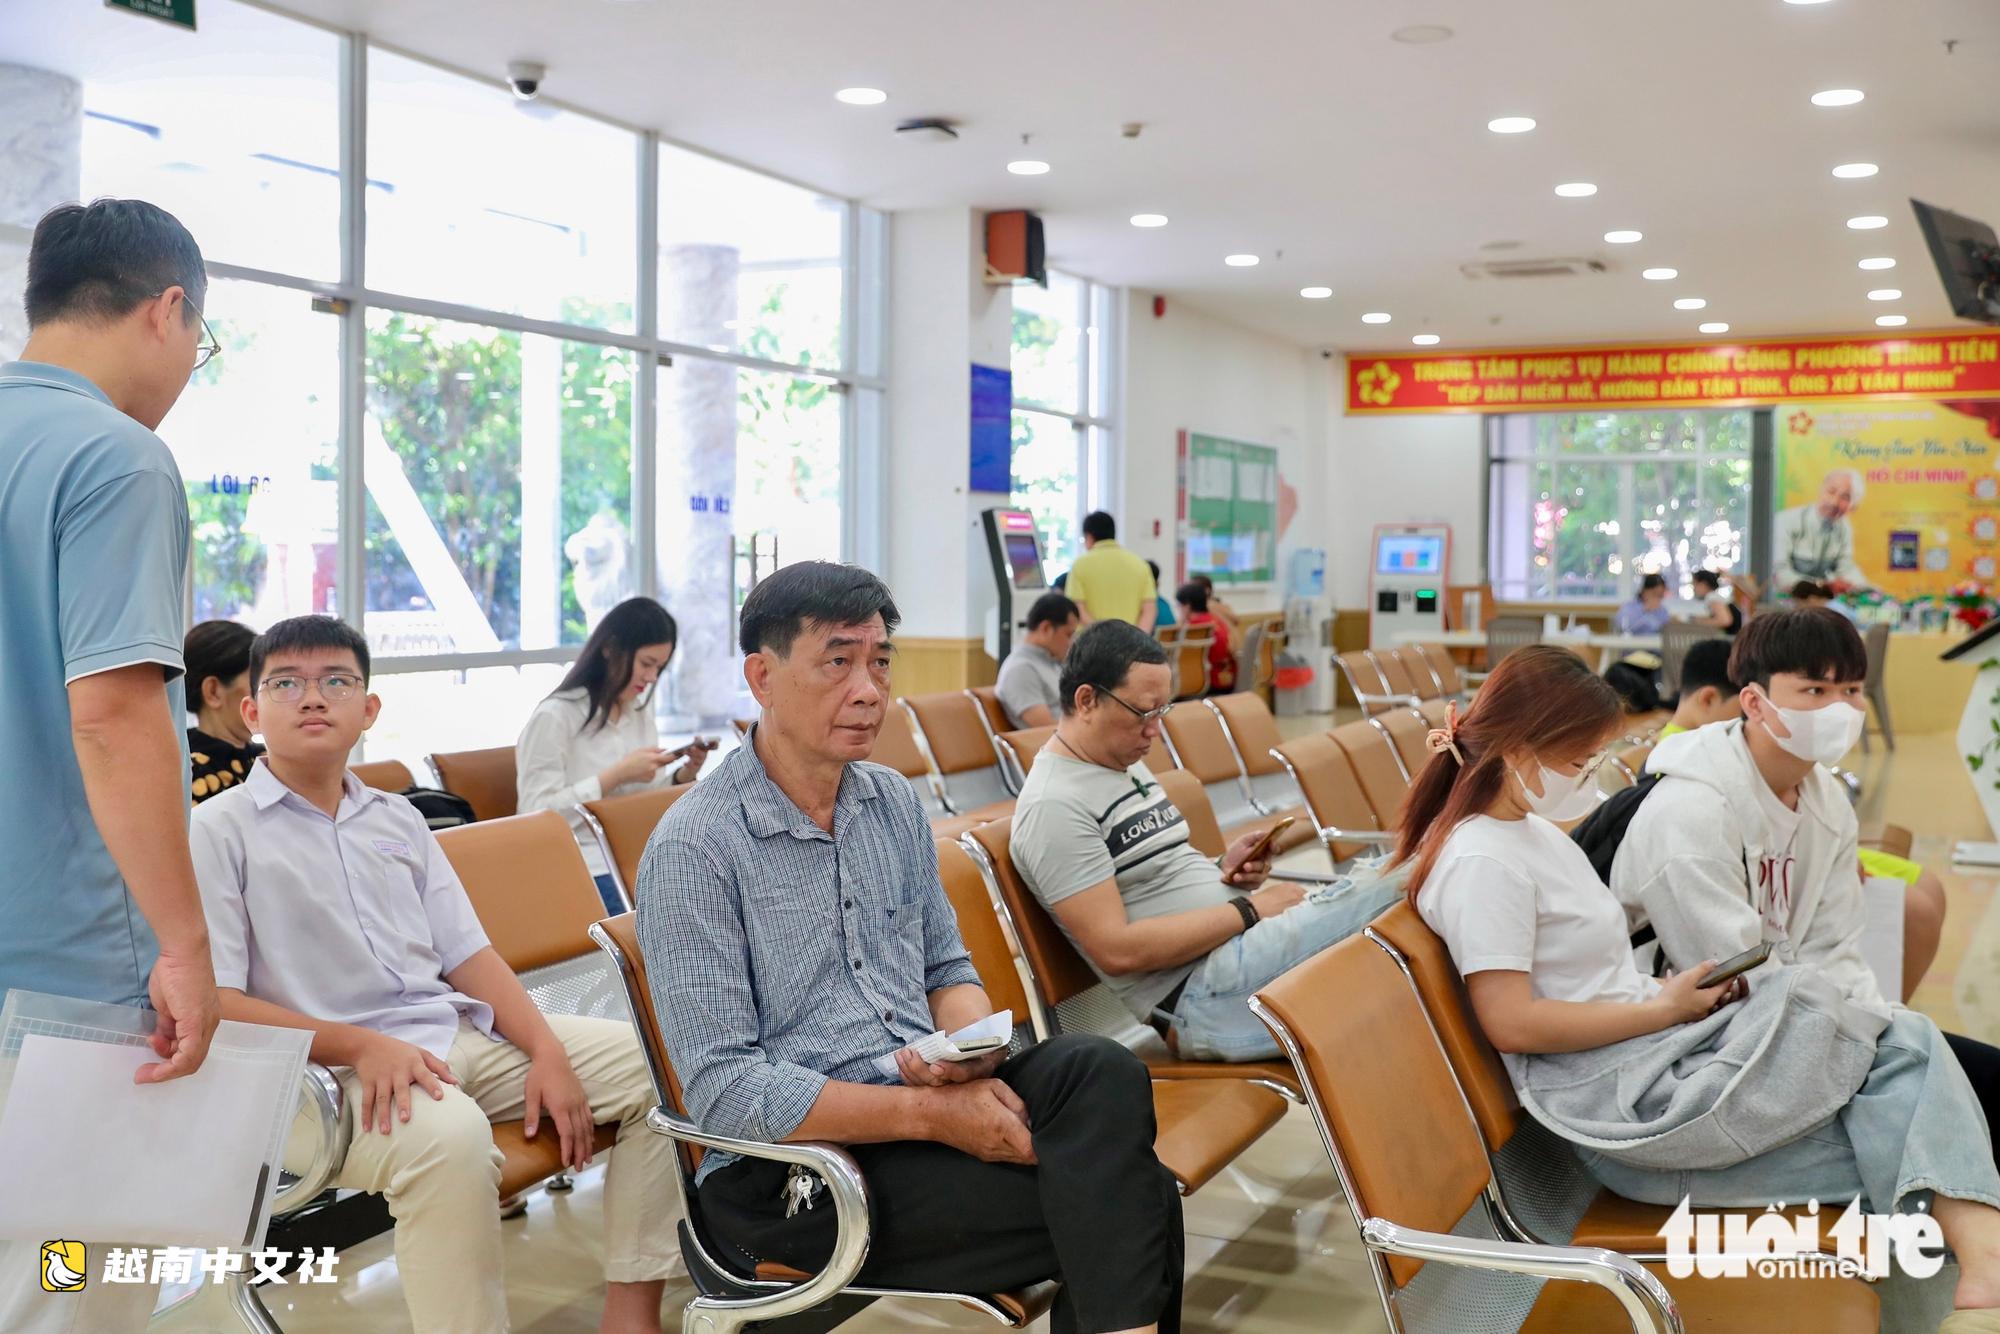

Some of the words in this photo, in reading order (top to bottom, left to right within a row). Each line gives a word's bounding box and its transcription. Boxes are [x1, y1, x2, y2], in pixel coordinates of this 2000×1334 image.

[1413, 360, 1473, 382] TRUNG
[1477, 357, 1517, 379] TÂM
[1521, 357, 1573, 379] PHỤC
[1577, 355, 1603, 379] VỤ
[1607, 351, 1662, 375] HÀNH
[1666, 349, 1729, 373] CHÍNH
[1733, 347, 1791, 371] CÔNG
[1795, 342, 1884, 369] PHƯỜNG
